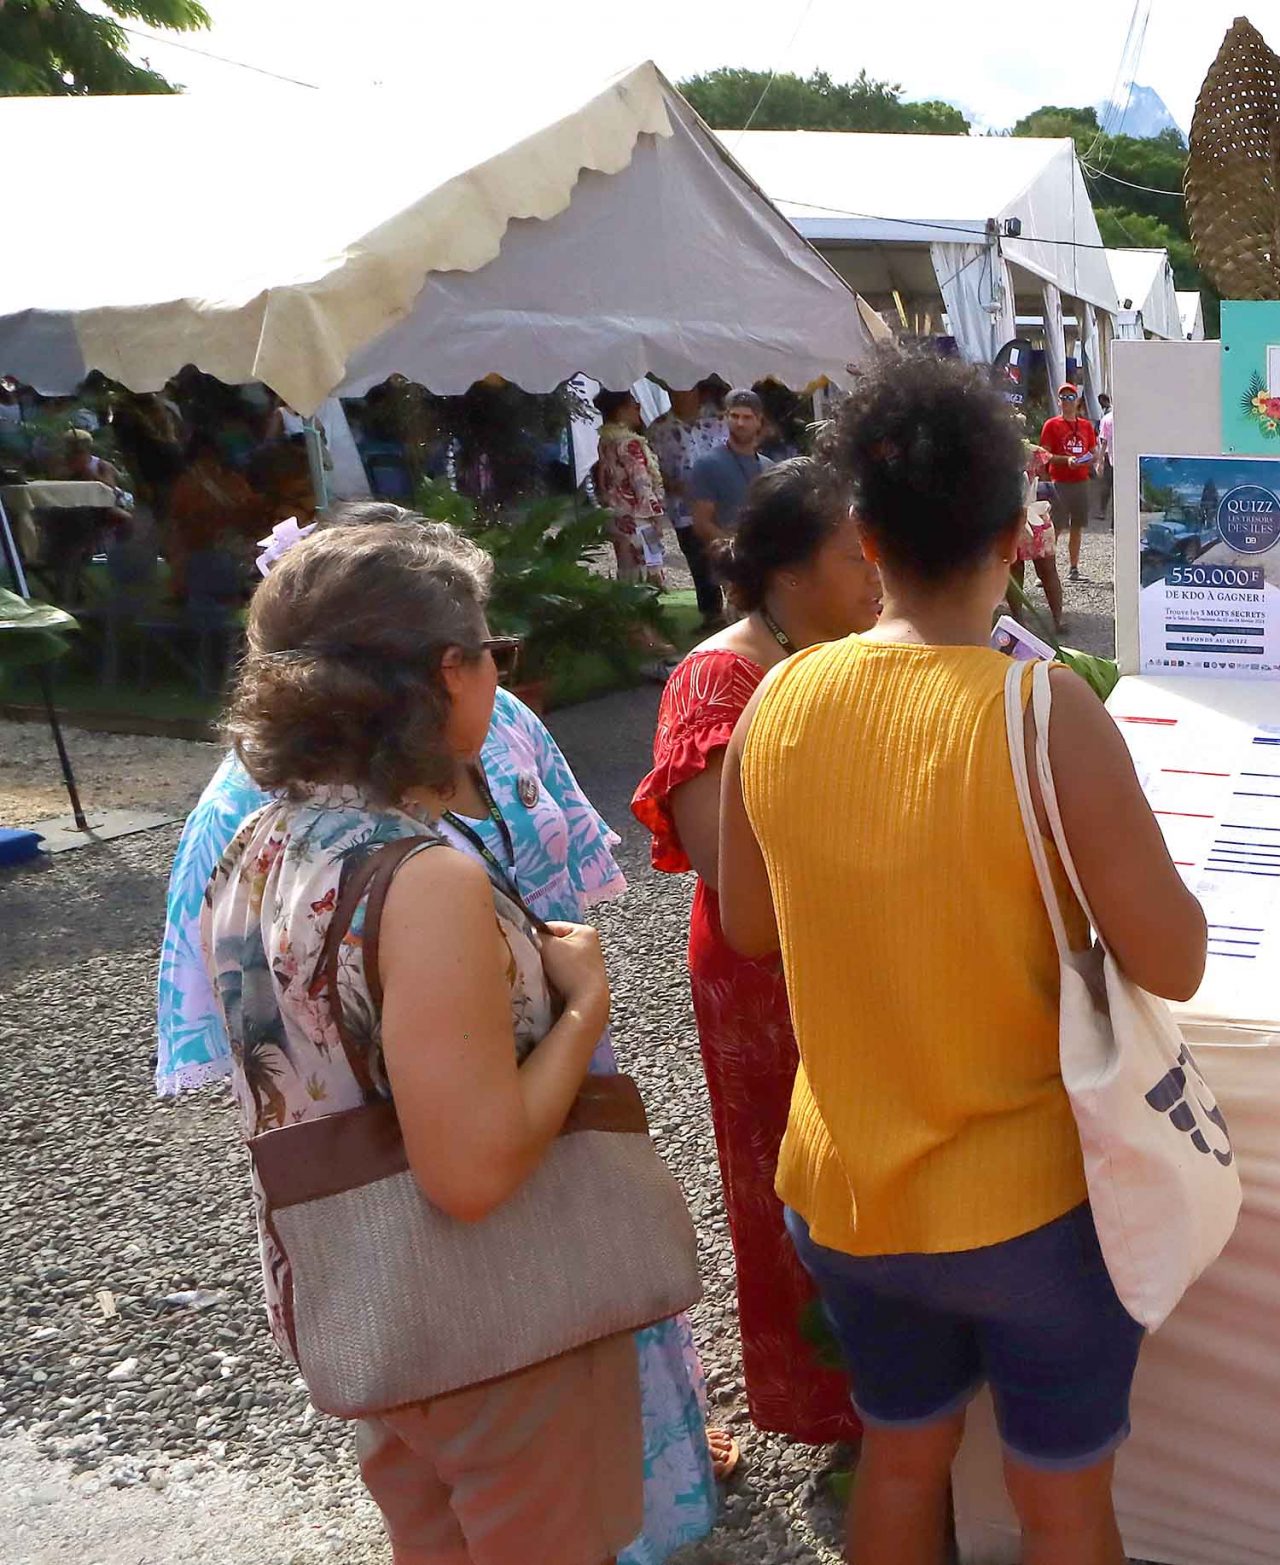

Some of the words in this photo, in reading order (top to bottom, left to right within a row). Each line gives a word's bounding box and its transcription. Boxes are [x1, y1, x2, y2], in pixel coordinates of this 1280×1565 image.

[1227, 499, 1273, 514] QUIZZ
[1228, 523, 1249, 533] DES
[1165, 590, 1179, 599] DE
[1182, 591, 1205, 600] KDO
[1217, 592, 1260, 602] GAGNER
[1206, 609, 1230, 618] MOTS
[1231, 610, 1266, 619] SECRETS
